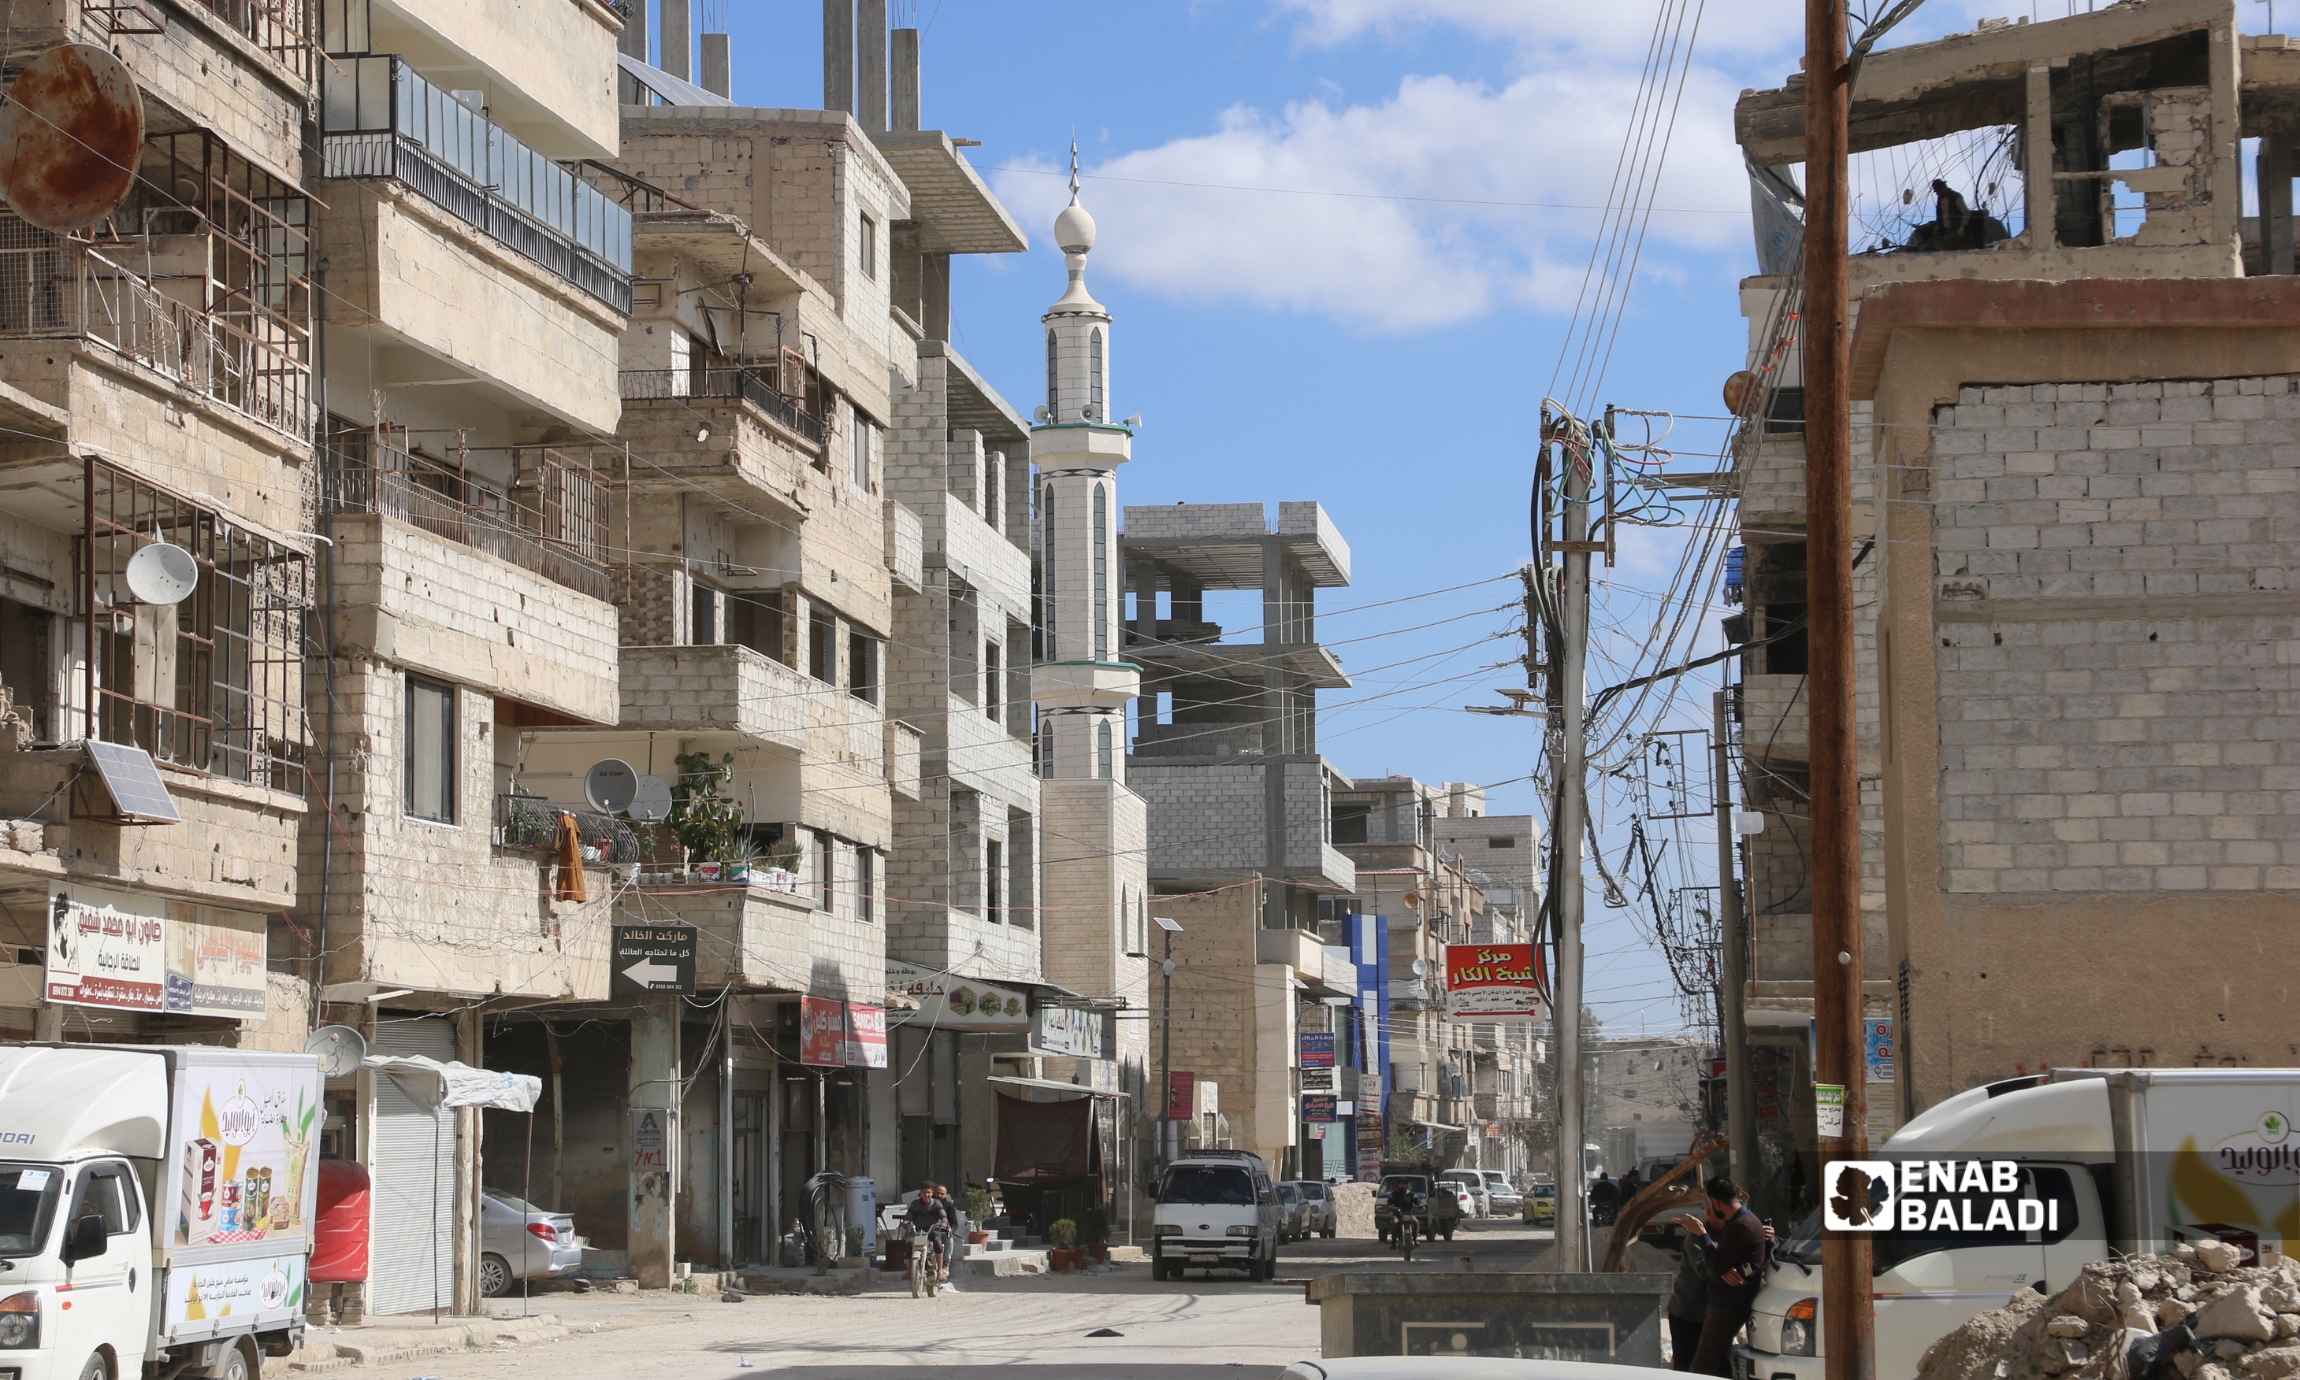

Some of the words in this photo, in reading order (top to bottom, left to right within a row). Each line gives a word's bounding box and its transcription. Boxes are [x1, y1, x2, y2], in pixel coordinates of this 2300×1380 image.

[78, 906, 101, 937] شفيق
[102, 914, 124, 937] محمد
[624, 930, 652, 941] الخالد
[656, 930, 688, 943] ماركت
[620, 948, 642, 956] العائلة
[644, 948, 668, 958] تحتاجه
[679, 948, 690, 958] كل
[1477, 948, 1512, 964] مركز
[98, 950, 119, 973] الرجالية
[900, 966, 917, 976] بوظة
[1453, 966, 1492, 985] الكار
[1496, 966, 1534, 984] شيخ
[234, 1274, 248, 1284] مؤسسة
